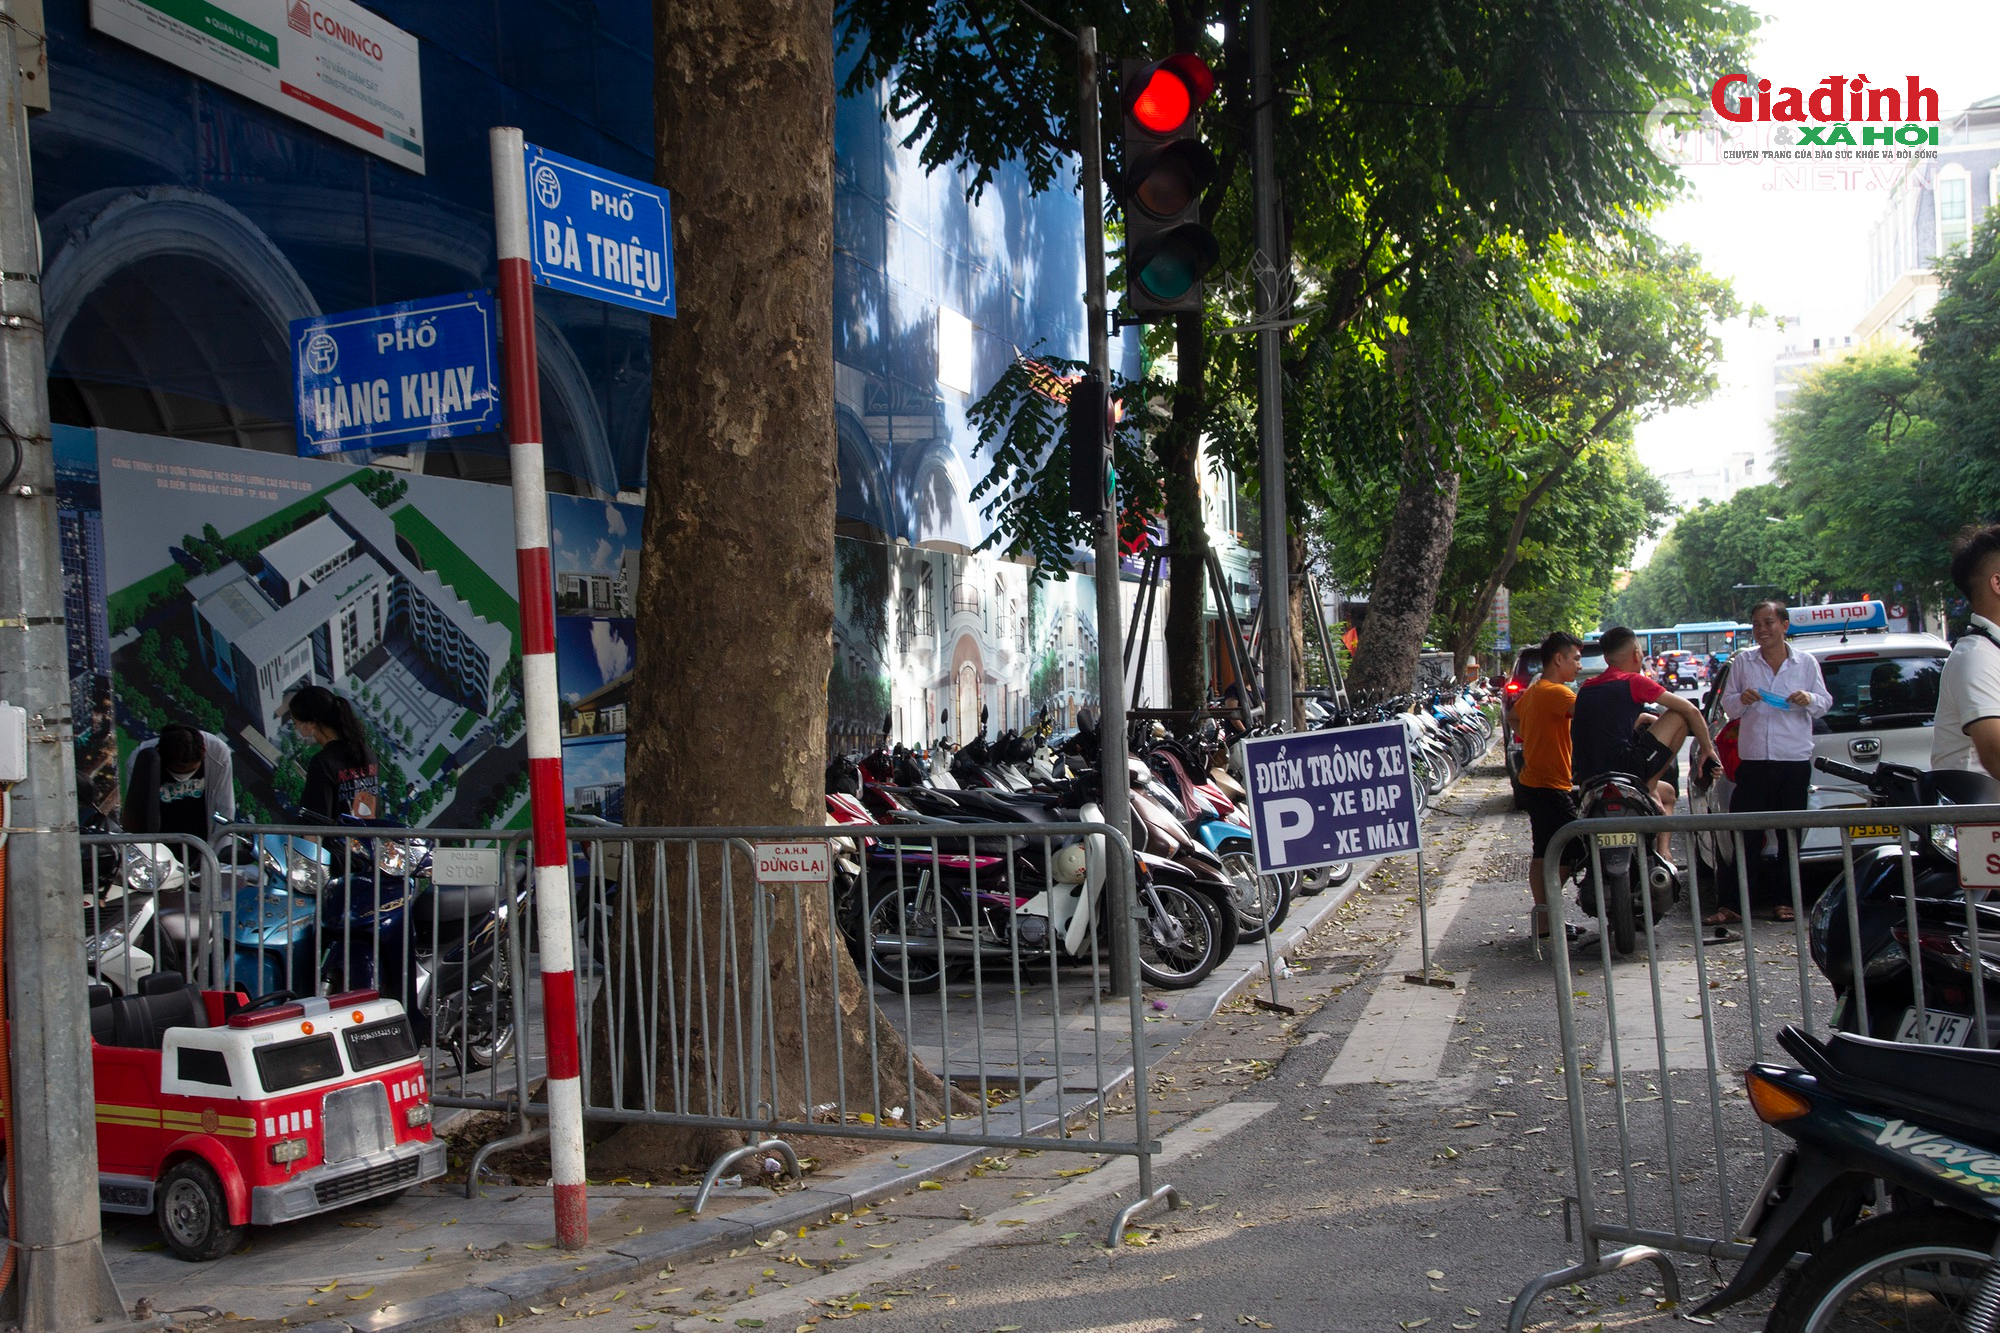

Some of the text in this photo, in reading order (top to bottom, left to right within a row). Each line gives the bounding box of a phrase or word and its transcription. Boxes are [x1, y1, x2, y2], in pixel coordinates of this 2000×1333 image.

[211, 16, 235, 37] QUẢN
[235, 29, 245, 42] LÝ
[259, 40, 271, 54] ÁN
[313, 11, 383, 62] CONINCO
[322, 73, 371, 104] CONSTRUCTION
[591, 190, 634, 222] PHỐ
[543, 215, 662, 297] BÀ TRIỆU
[377, 316, 437, 355] PHỐ
[313, 365, 475, 432] HÀNG KHAY
[214, 470, 229, 481] THCS
[1855, 744, 1875, 752] KIA
[1256, 743, 1404, 794] ĐIỂM TRÔNG XE
[1330, 790, 1357, 817] XE
[1361, 784, 1402, 816] ĐẠP
[1262, 797, 1315, 867] P
[1335, 828, 1362, 855] XE
[1366, 818, 1410, 851] MÁY
[452, 852, 479, 861] POLICE
[760, 856, 824, 874] DỪNG LẠI
[775, 847, 808, 855] C.A.H.N
[446, 864, 484, 879] STOP
[135, 965, 151, 973] HONDA
[1875, 1119, 2000, 1176] Wave
